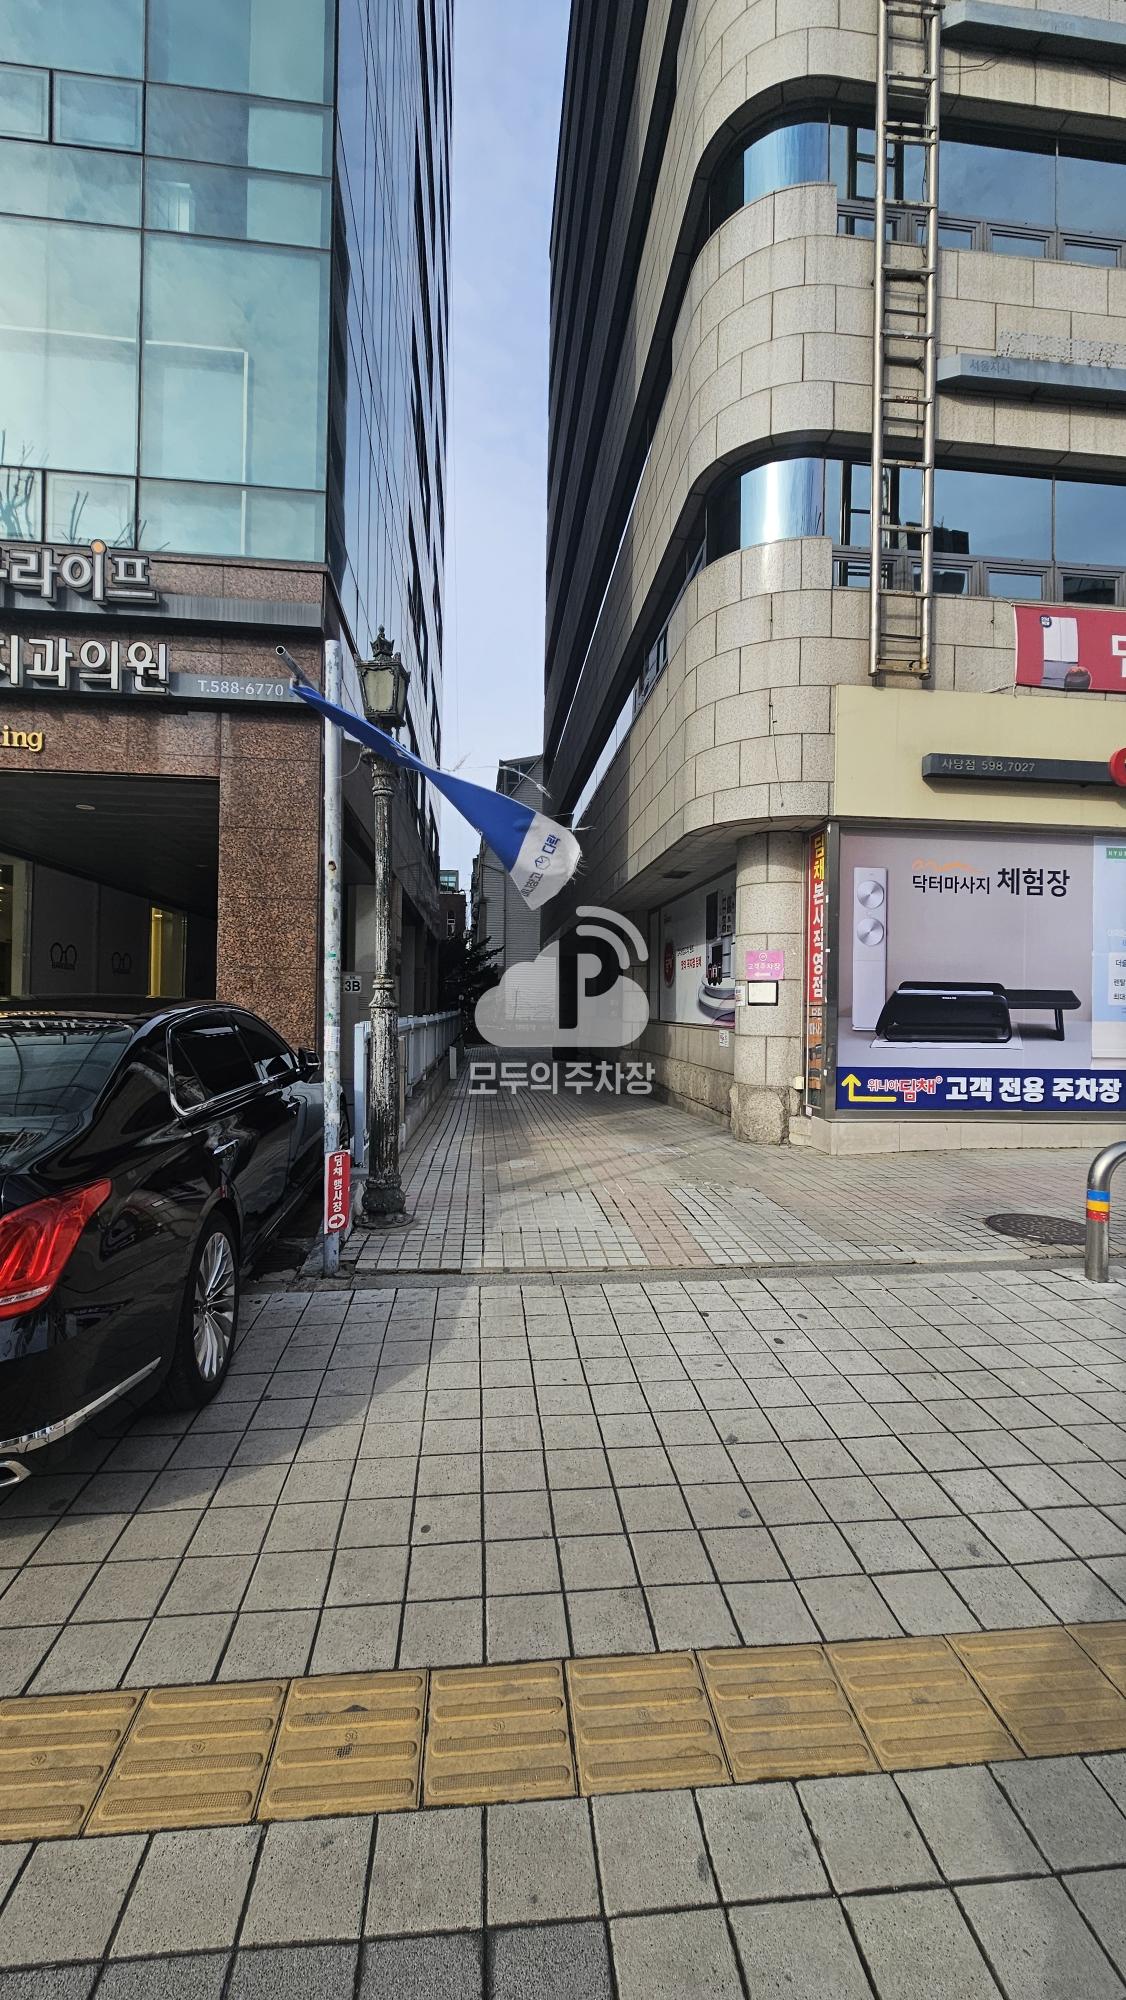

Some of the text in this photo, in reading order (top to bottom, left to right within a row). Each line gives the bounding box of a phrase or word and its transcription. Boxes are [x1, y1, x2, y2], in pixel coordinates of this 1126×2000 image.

[0, 538, 157, 602] 라이프
[197, 679, 284, 697] T.588-6770
[0, 725, 43, 751] ing
[942, 757, 1036, 773] 사당점 598.7027
[812, 837, 825, 880] 딤채
[912, 867, 1070, 897] 닥터마사지 체험장
[344, 981, 360, 991] 3B
[945, 1076, 992, 1102] 고객
[998, 1077, 1044, 1102] 전용
[1052, 1077, 1122, 1103] 주차장
[333, 1155, 343, 1212] 딤채 행사장
